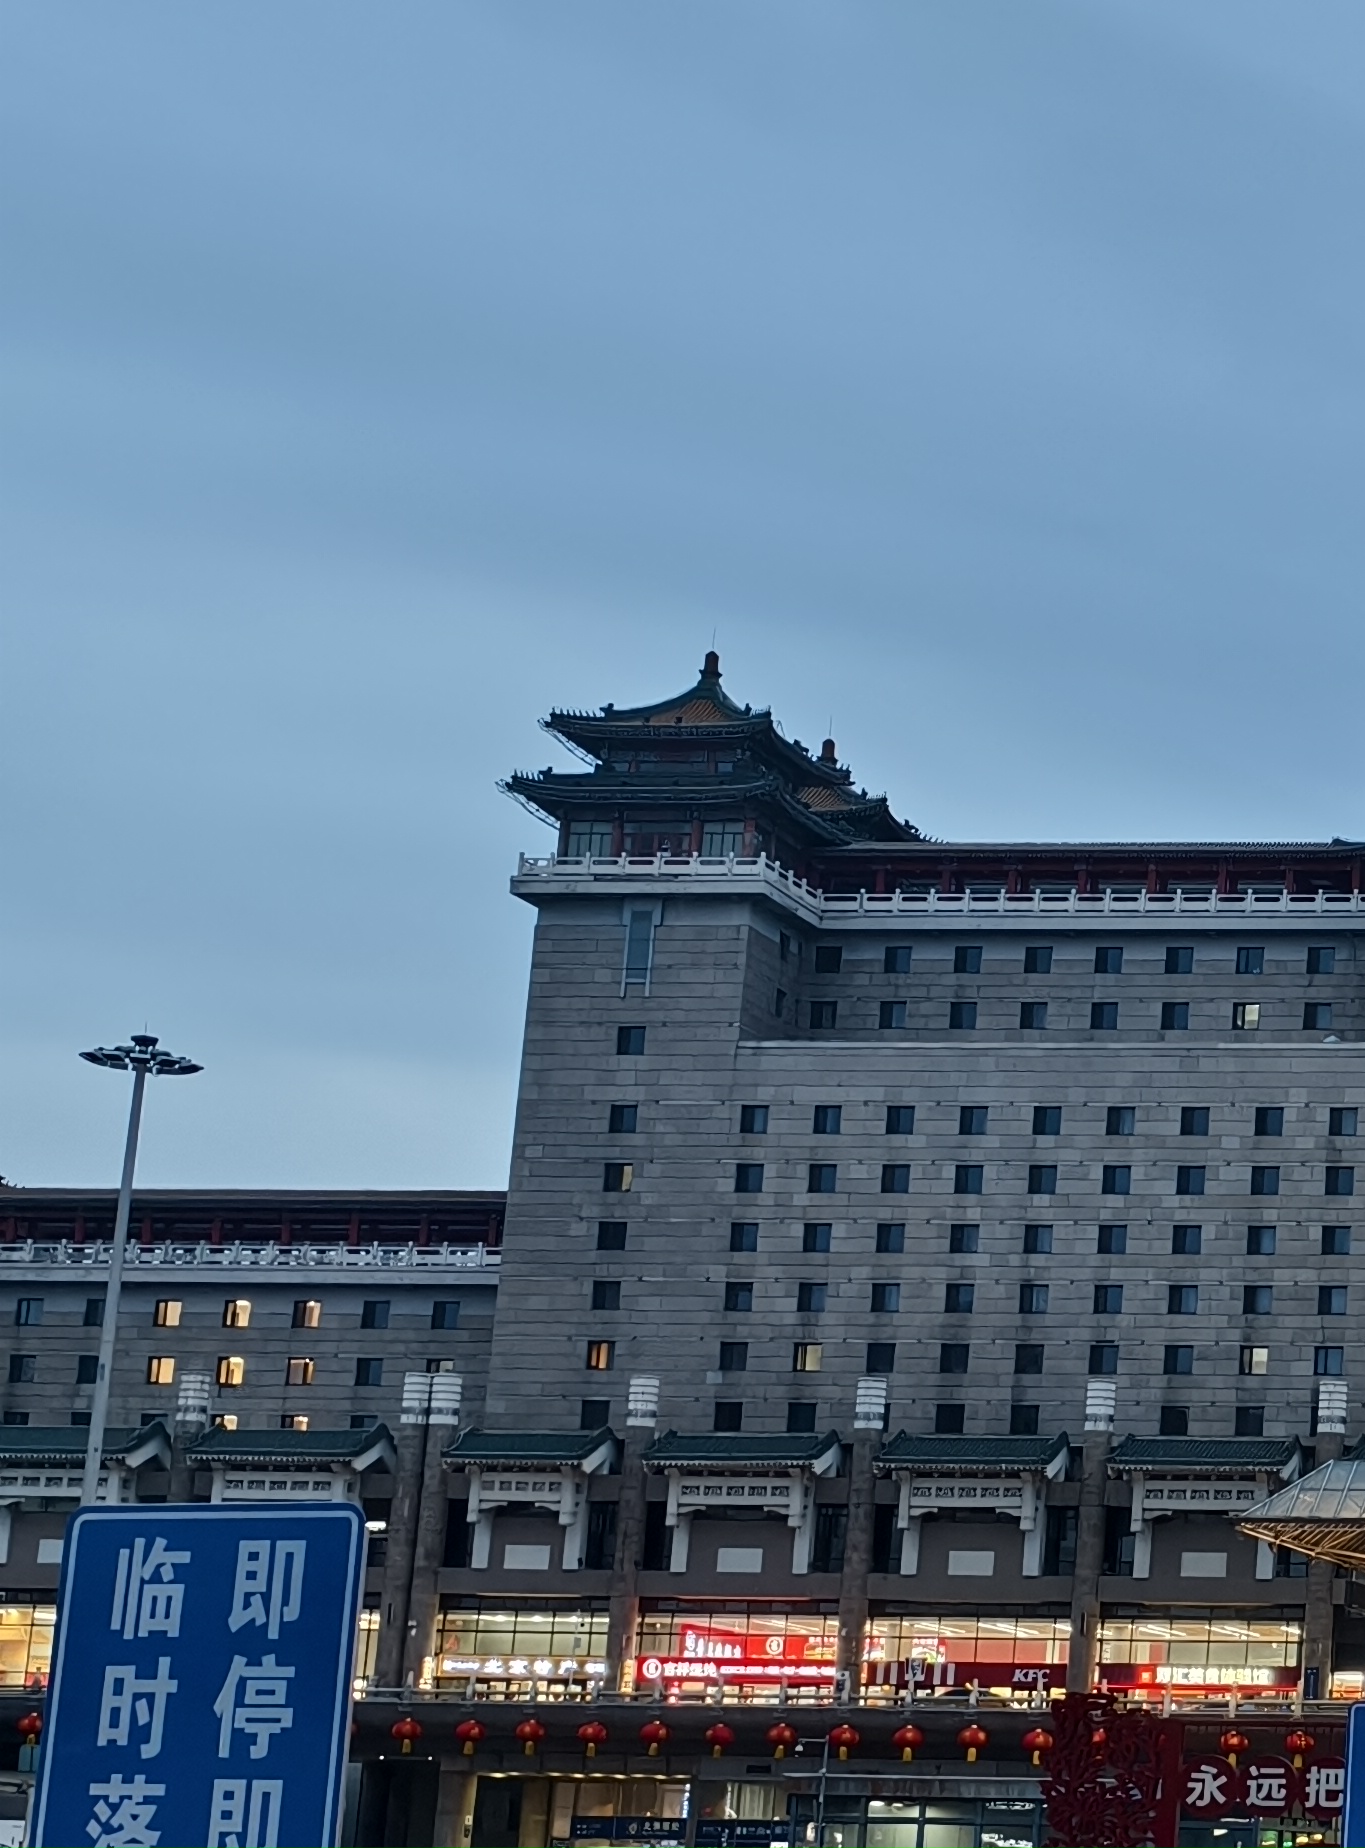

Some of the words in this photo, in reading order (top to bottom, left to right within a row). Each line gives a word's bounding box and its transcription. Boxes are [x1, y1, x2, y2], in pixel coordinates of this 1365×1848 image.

[1012, 1669, 1050, 1682] KFC
[1186, 1764, 1346, 1808] 永远把
